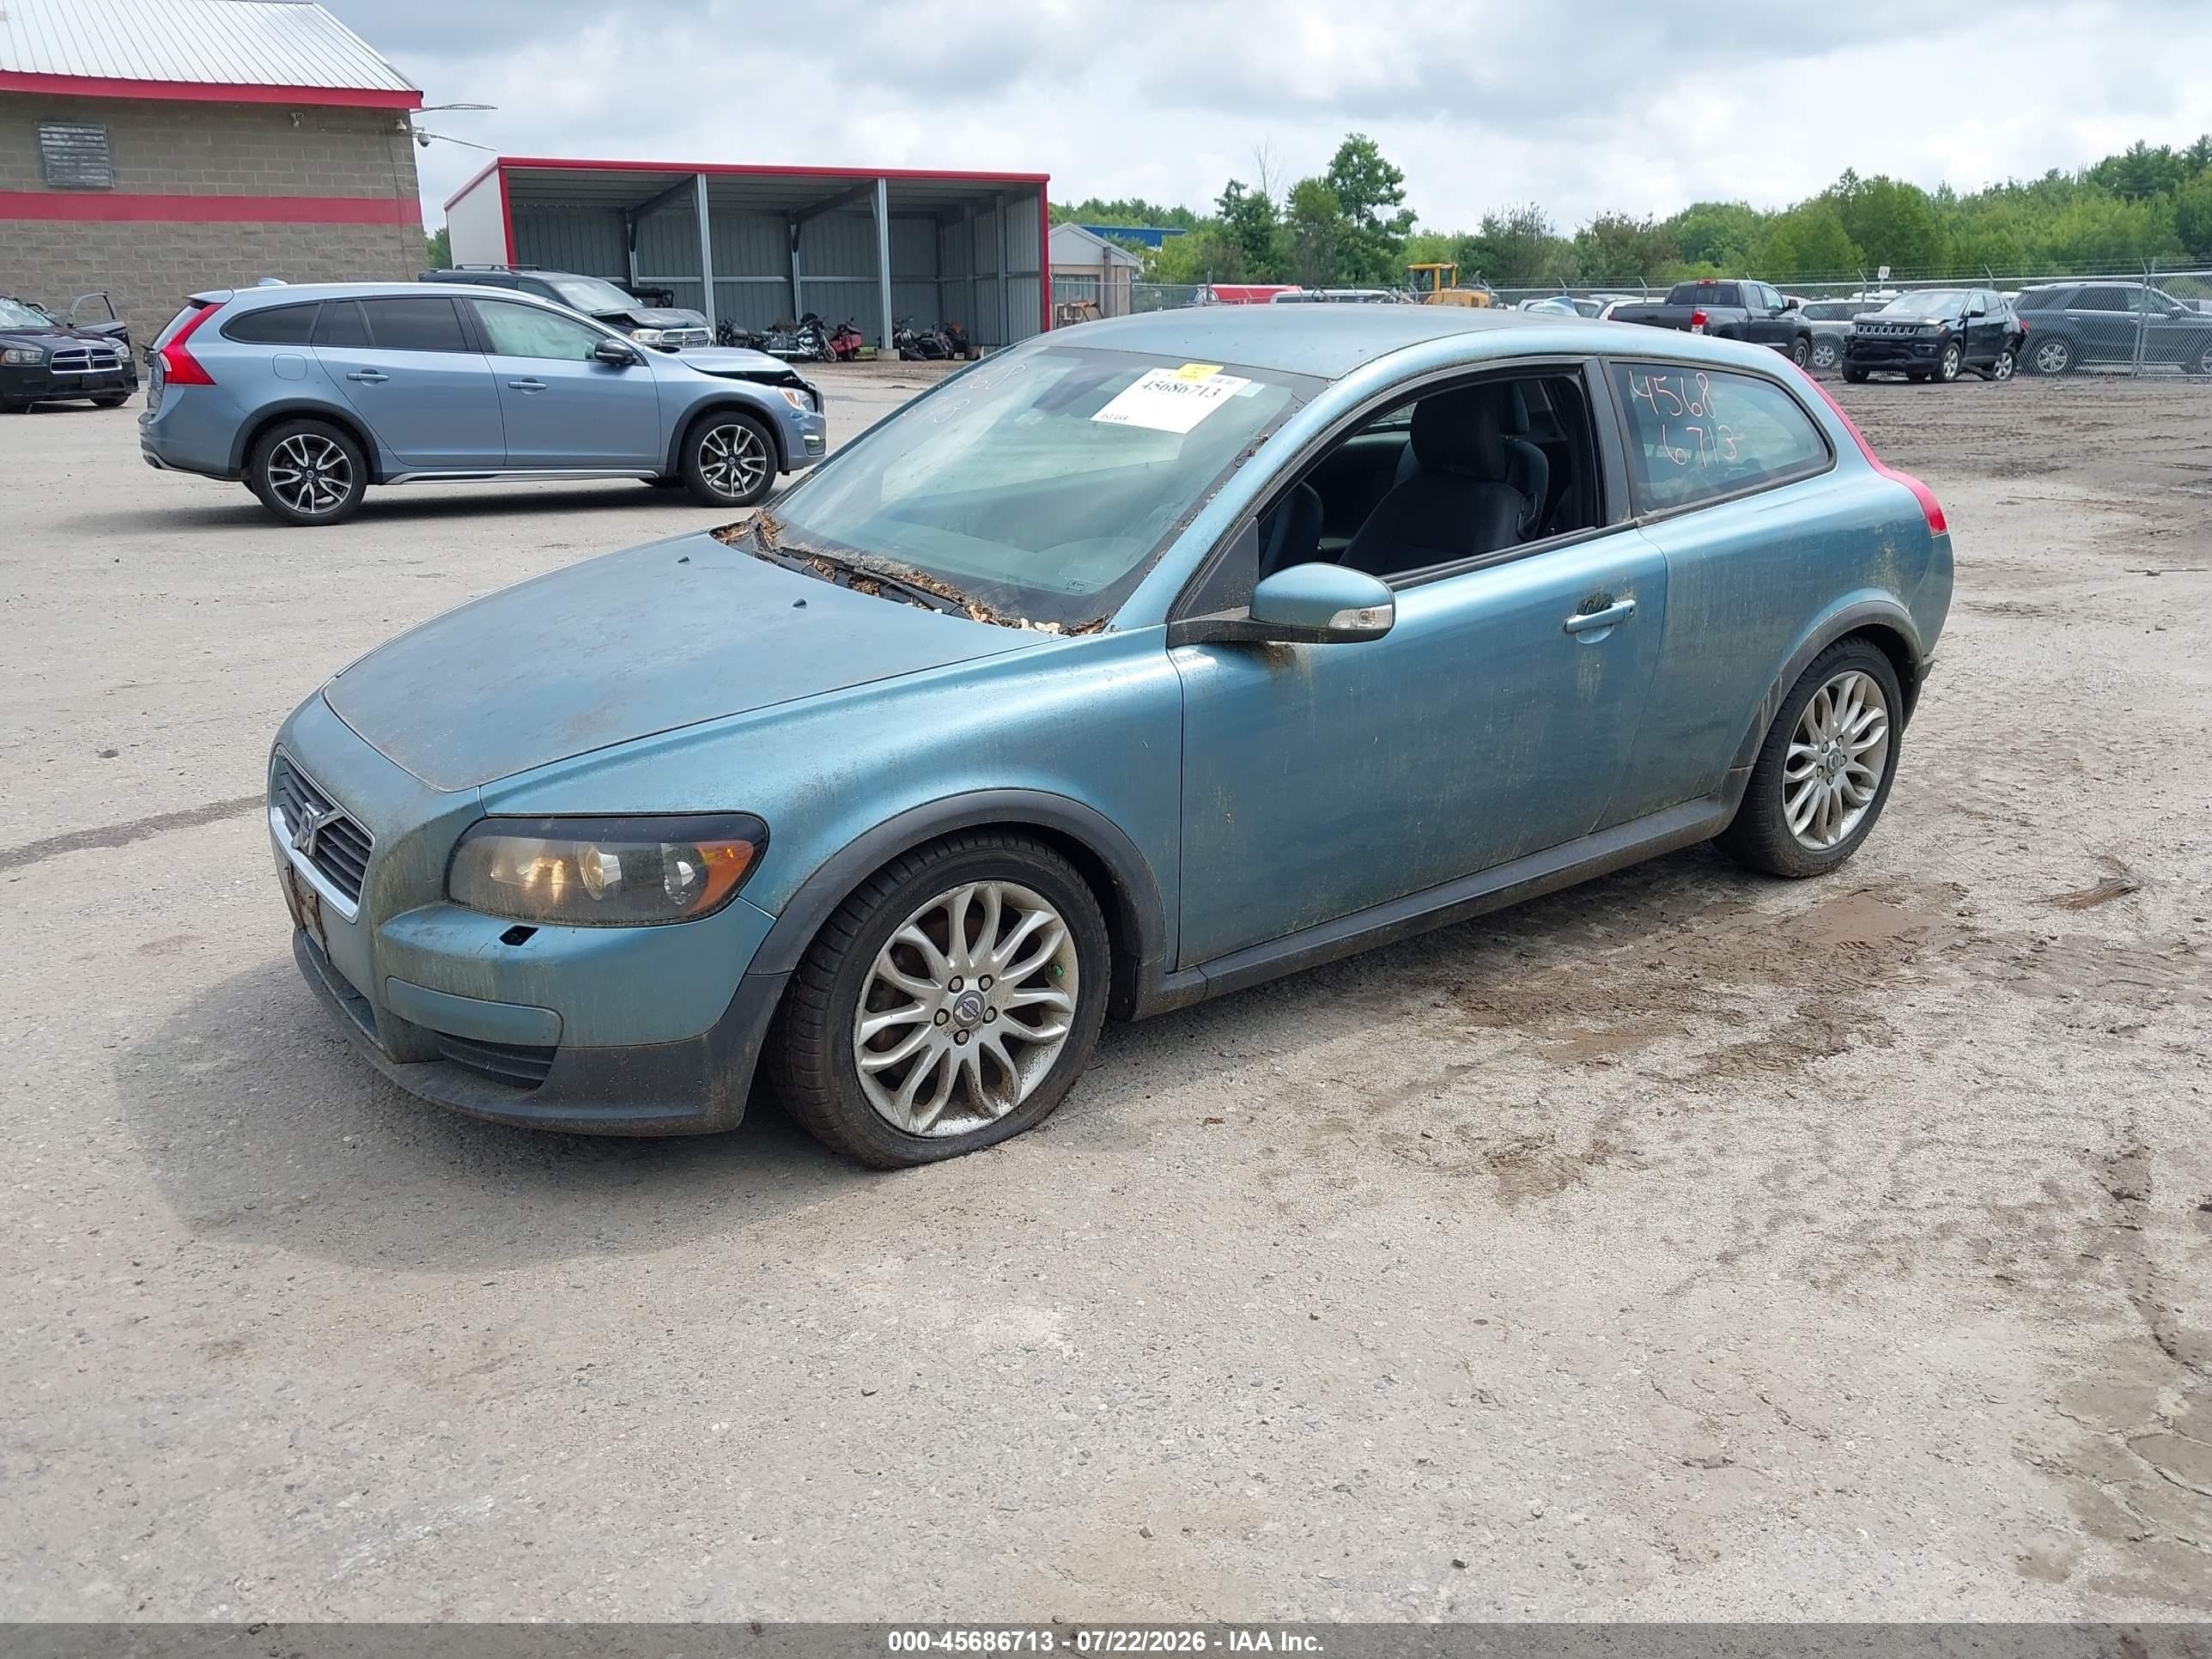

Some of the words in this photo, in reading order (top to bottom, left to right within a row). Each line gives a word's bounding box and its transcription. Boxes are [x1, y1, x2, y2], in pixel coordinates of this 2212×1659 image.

[1141, 380, 1222, 398] 45686713
[1628, 370, 1717, 419] 4568
[1662, 424, 1740, 468] 6713
